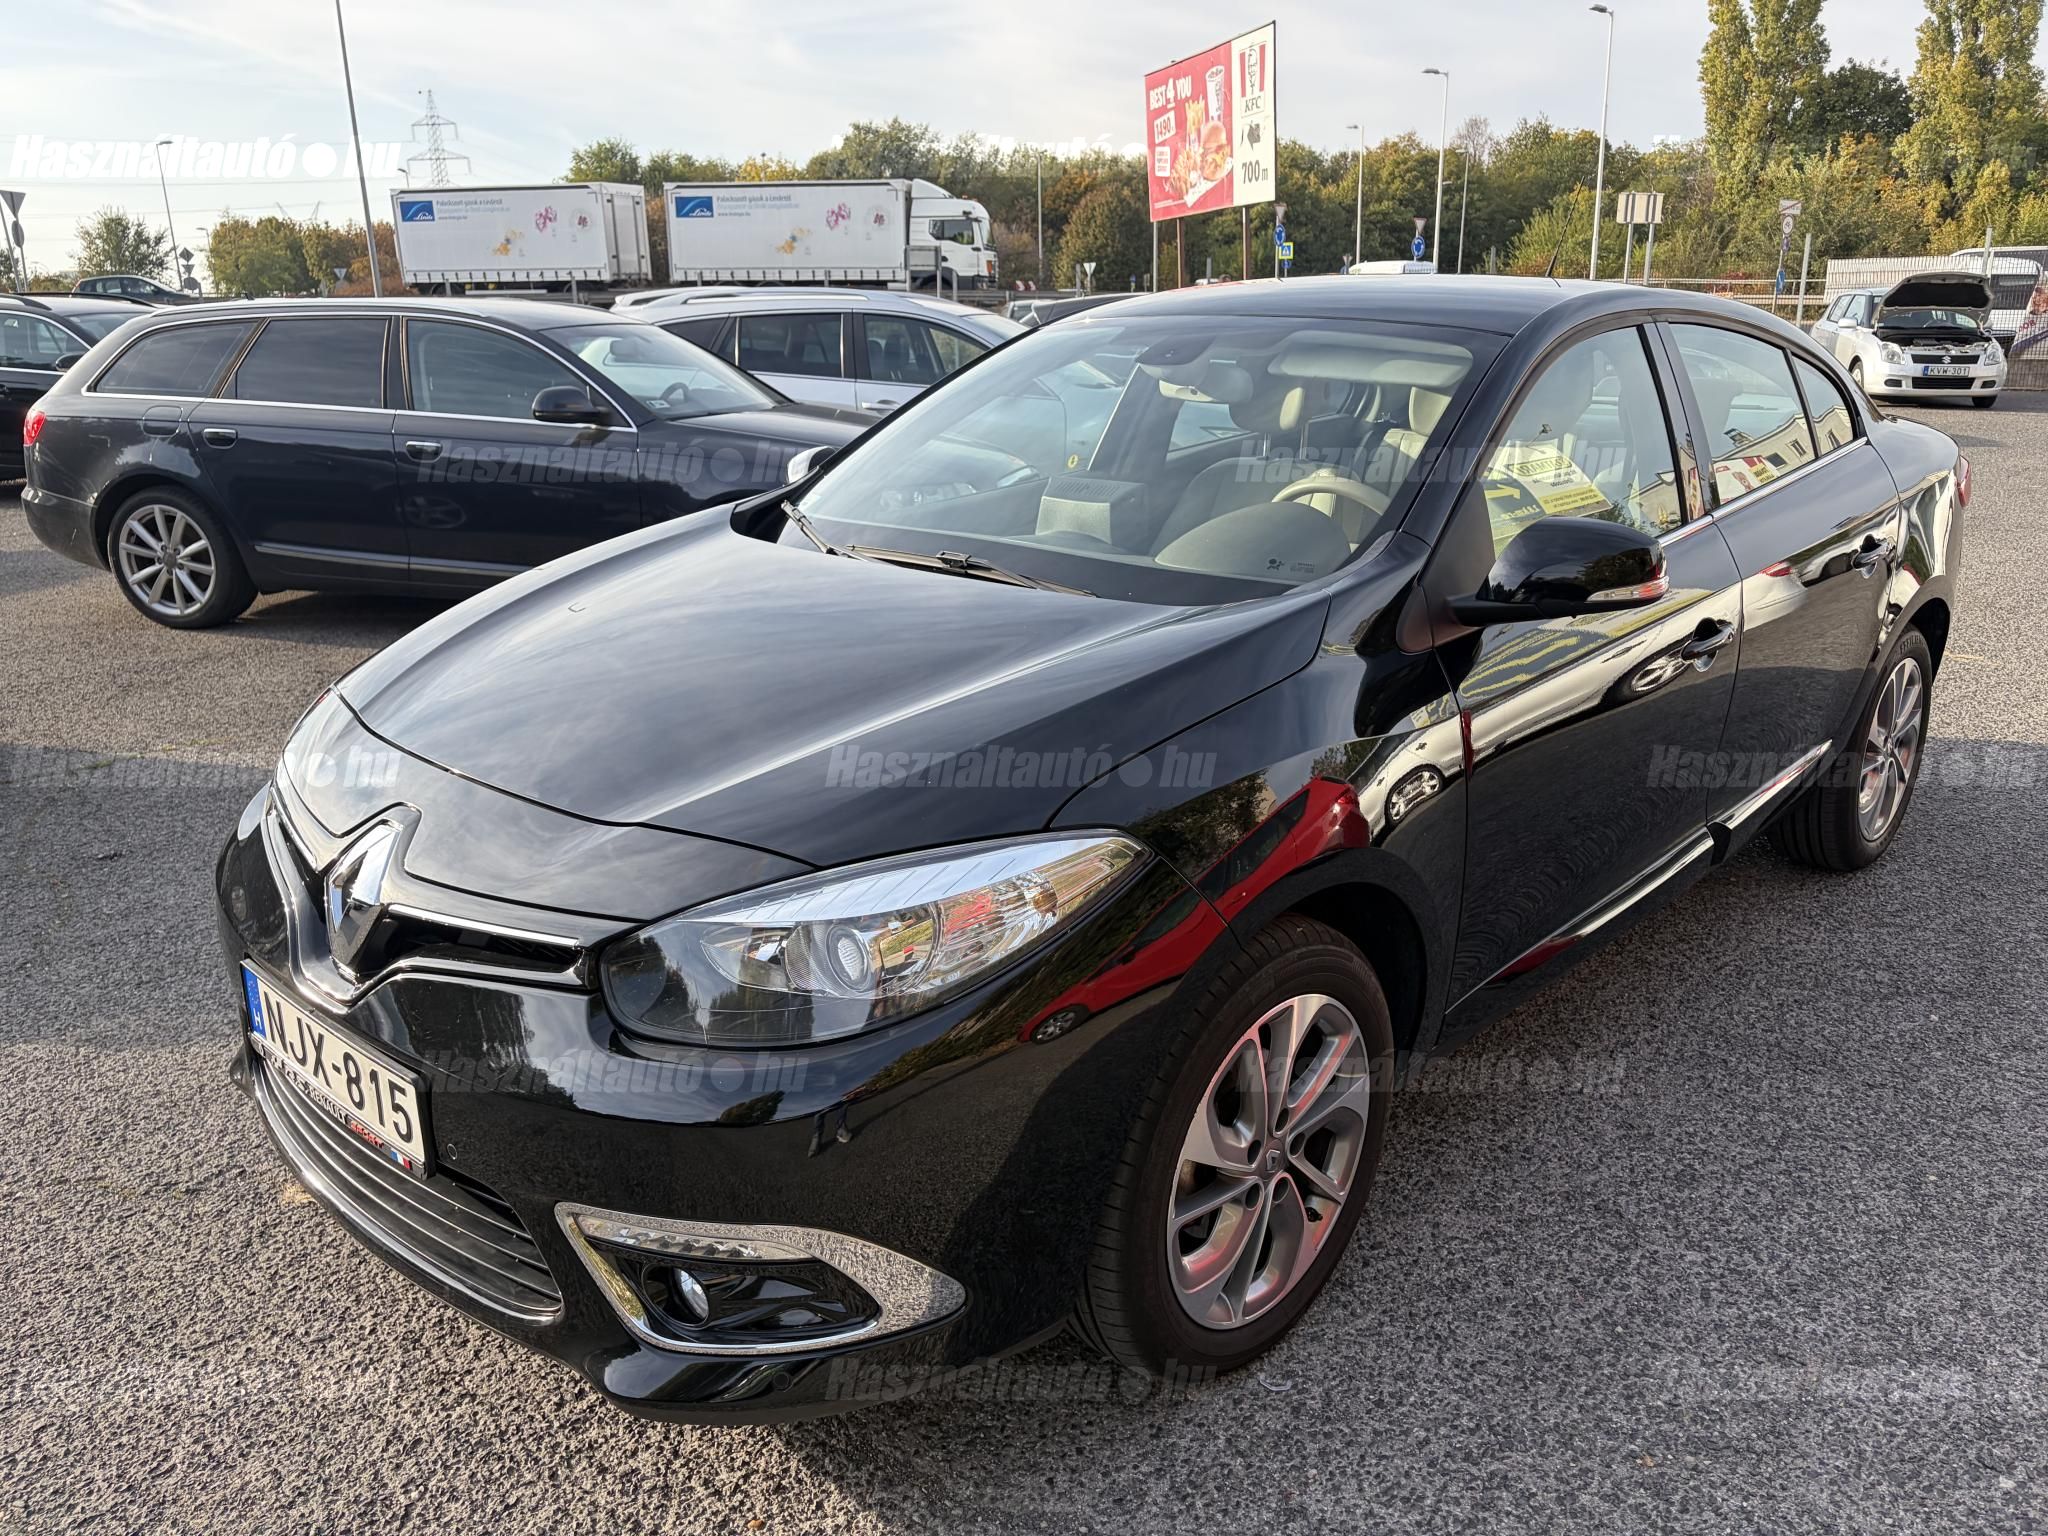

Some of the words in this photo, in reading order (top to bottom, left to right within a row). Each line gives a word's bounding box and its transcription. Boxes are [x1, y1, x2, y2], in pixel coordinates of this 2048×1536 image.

[1149, 85, 1166, 111] BEST
[1166, 78, 1175, 104] 4
[1175, 75, 1192, 100] YOU
[1244, 95, 1261, 113] KFC
[1241, 159, 1260, 185] 700
[1261, 167, 1269, 182] m
[1929, 366, 1968, 376] KVW-301
[264, 991, 414, 1144] NJX-815
[309, 1088, 348, 1125] RENAULT
